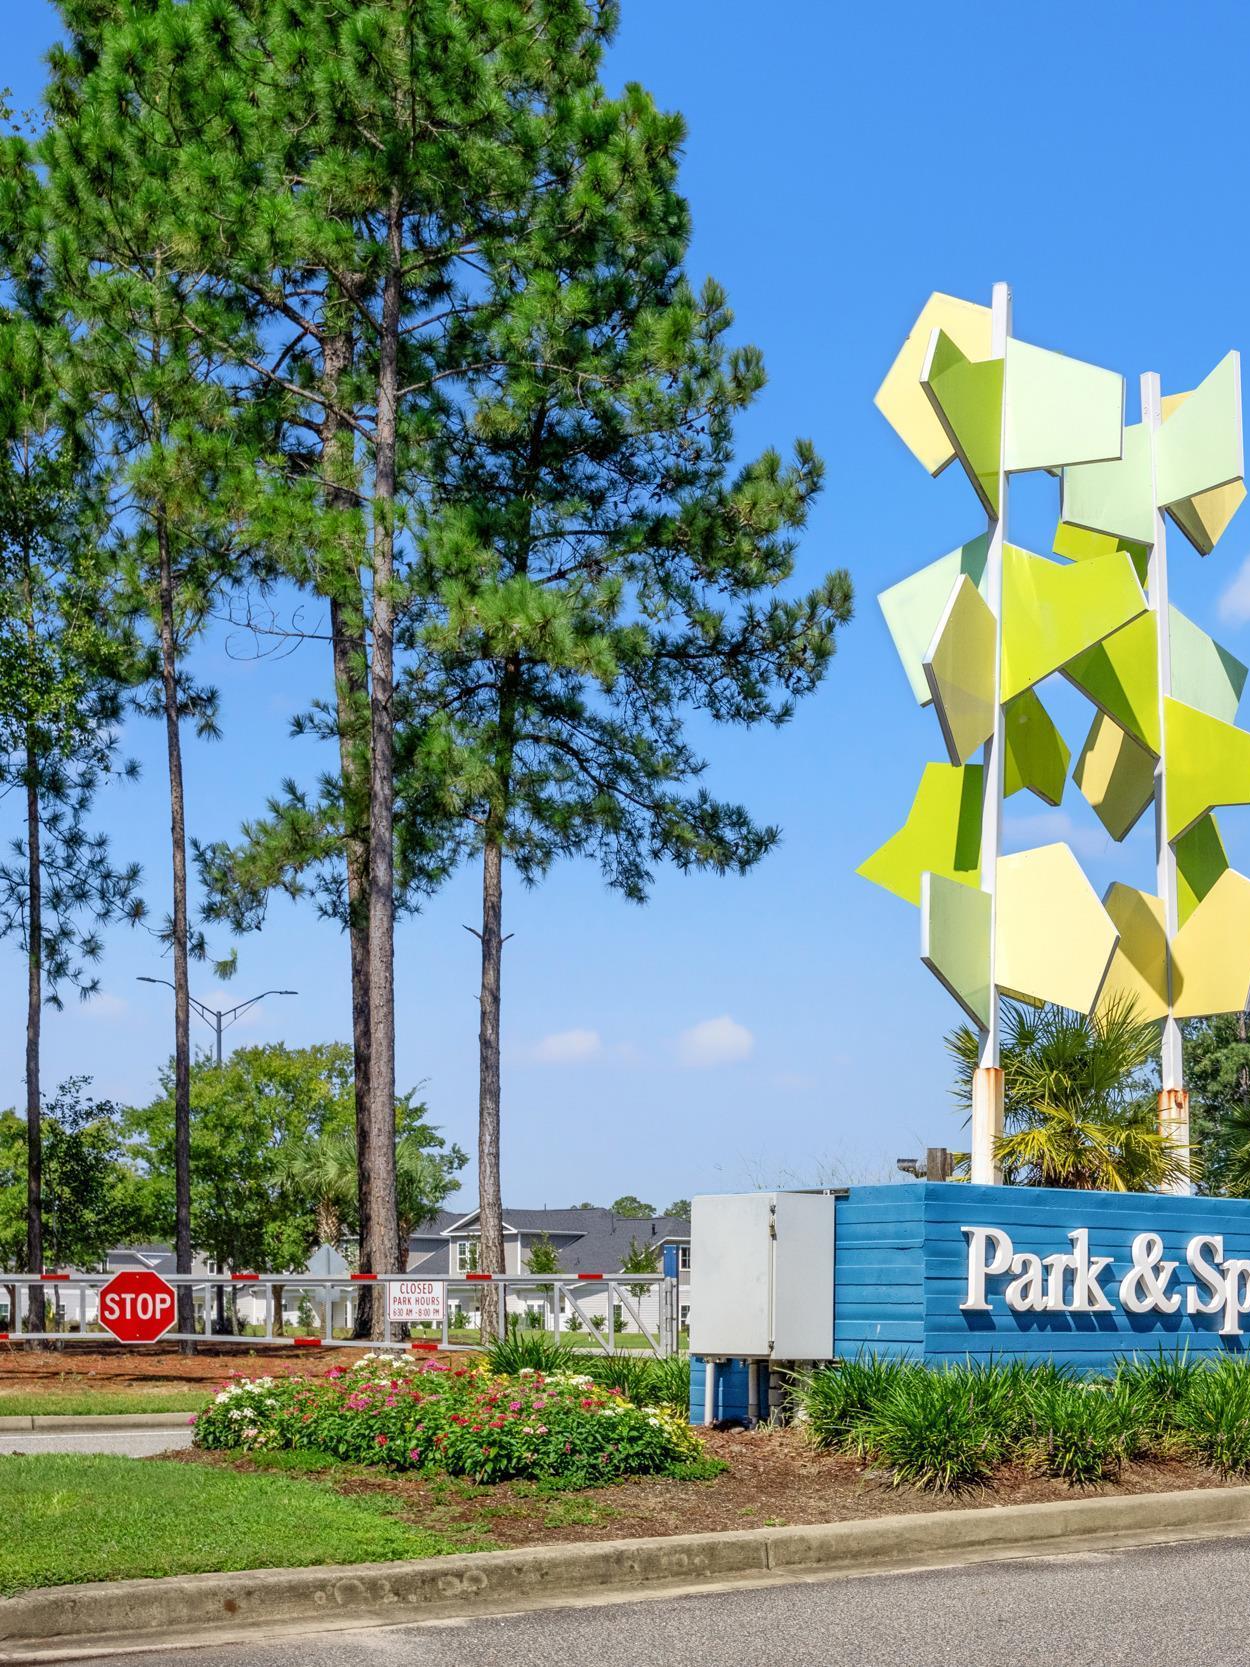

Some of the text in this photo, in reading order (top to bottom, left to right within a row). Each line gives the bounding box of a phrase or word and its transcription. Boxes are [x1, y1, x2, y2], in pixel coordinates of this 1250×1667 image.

[959, 1226, 1116, 1311] Park
[1119, 1232, 1181, 1313] &
[400, 1283, 433, 1294] CLOSED
[393, 1296, 440, 1305] PARK HOURS
[104, 1293, 171, 1320] STOP
[406, 1308, 413, 1317] AM
[433, 1308, 440, 1317] PM
